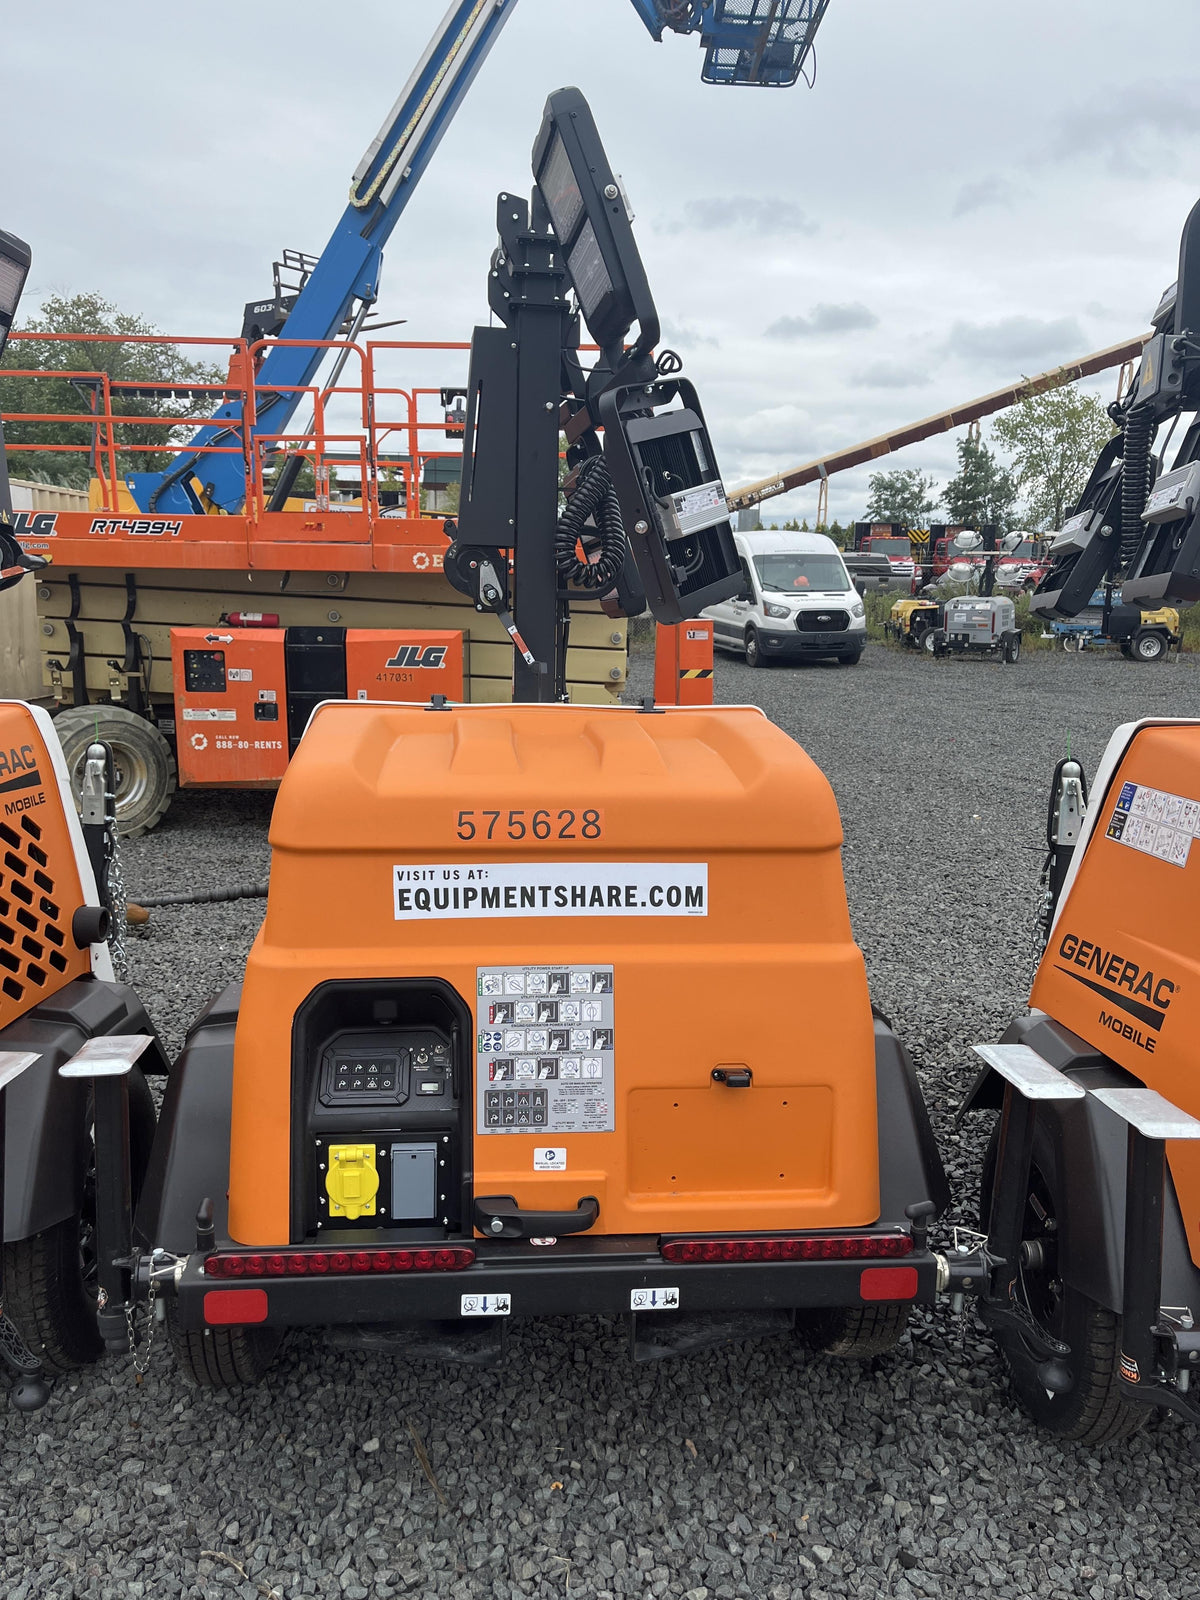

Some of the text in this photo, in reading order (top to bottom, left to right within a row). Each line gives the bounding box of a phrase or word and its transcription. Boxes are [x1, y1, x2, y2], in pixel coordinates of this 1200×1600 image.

[253, 304, 275, 313] 603
[89, 519, 183, 536] RT4394
[385, 645, 448, 669] JLG
[376, 673, 414, 681] 417031
[216, 741, 282, 749] 888-80-RENTS
[4, 792, 46, 816] MOBILE
[457, 809, 601, 840] 575628
[397, 870, 488, 881] VISIT US AT:
[398, 886, 703, 912] EQUIPMENTSHARE.COM
[1059, 933, 1175, 1009] GENERAC
[1098, 1011, 1157, 1054] MOBILE
